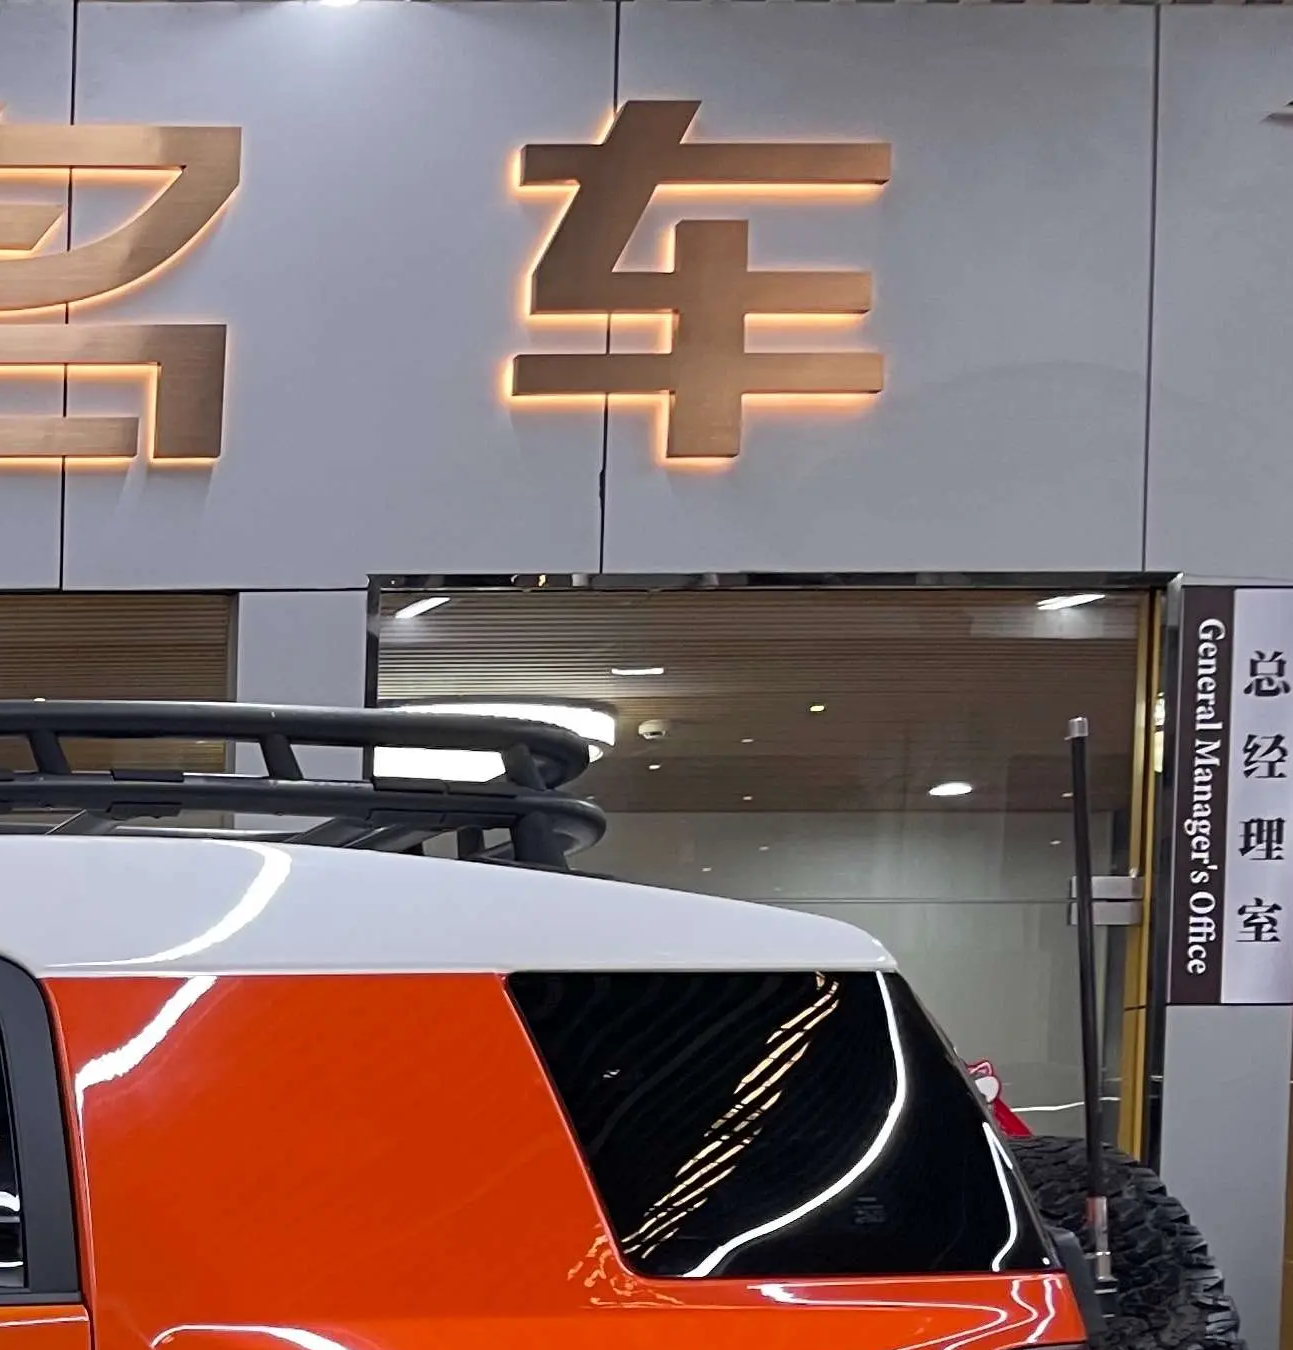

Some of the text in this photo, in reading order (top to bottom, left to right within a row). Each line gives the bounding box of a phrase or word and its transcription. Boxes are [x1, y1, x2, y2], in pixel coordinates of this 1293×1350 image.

[1184, 618, 1226, 976] General Manager's Office
[1236, 650, 1291, 944] 总经理室
